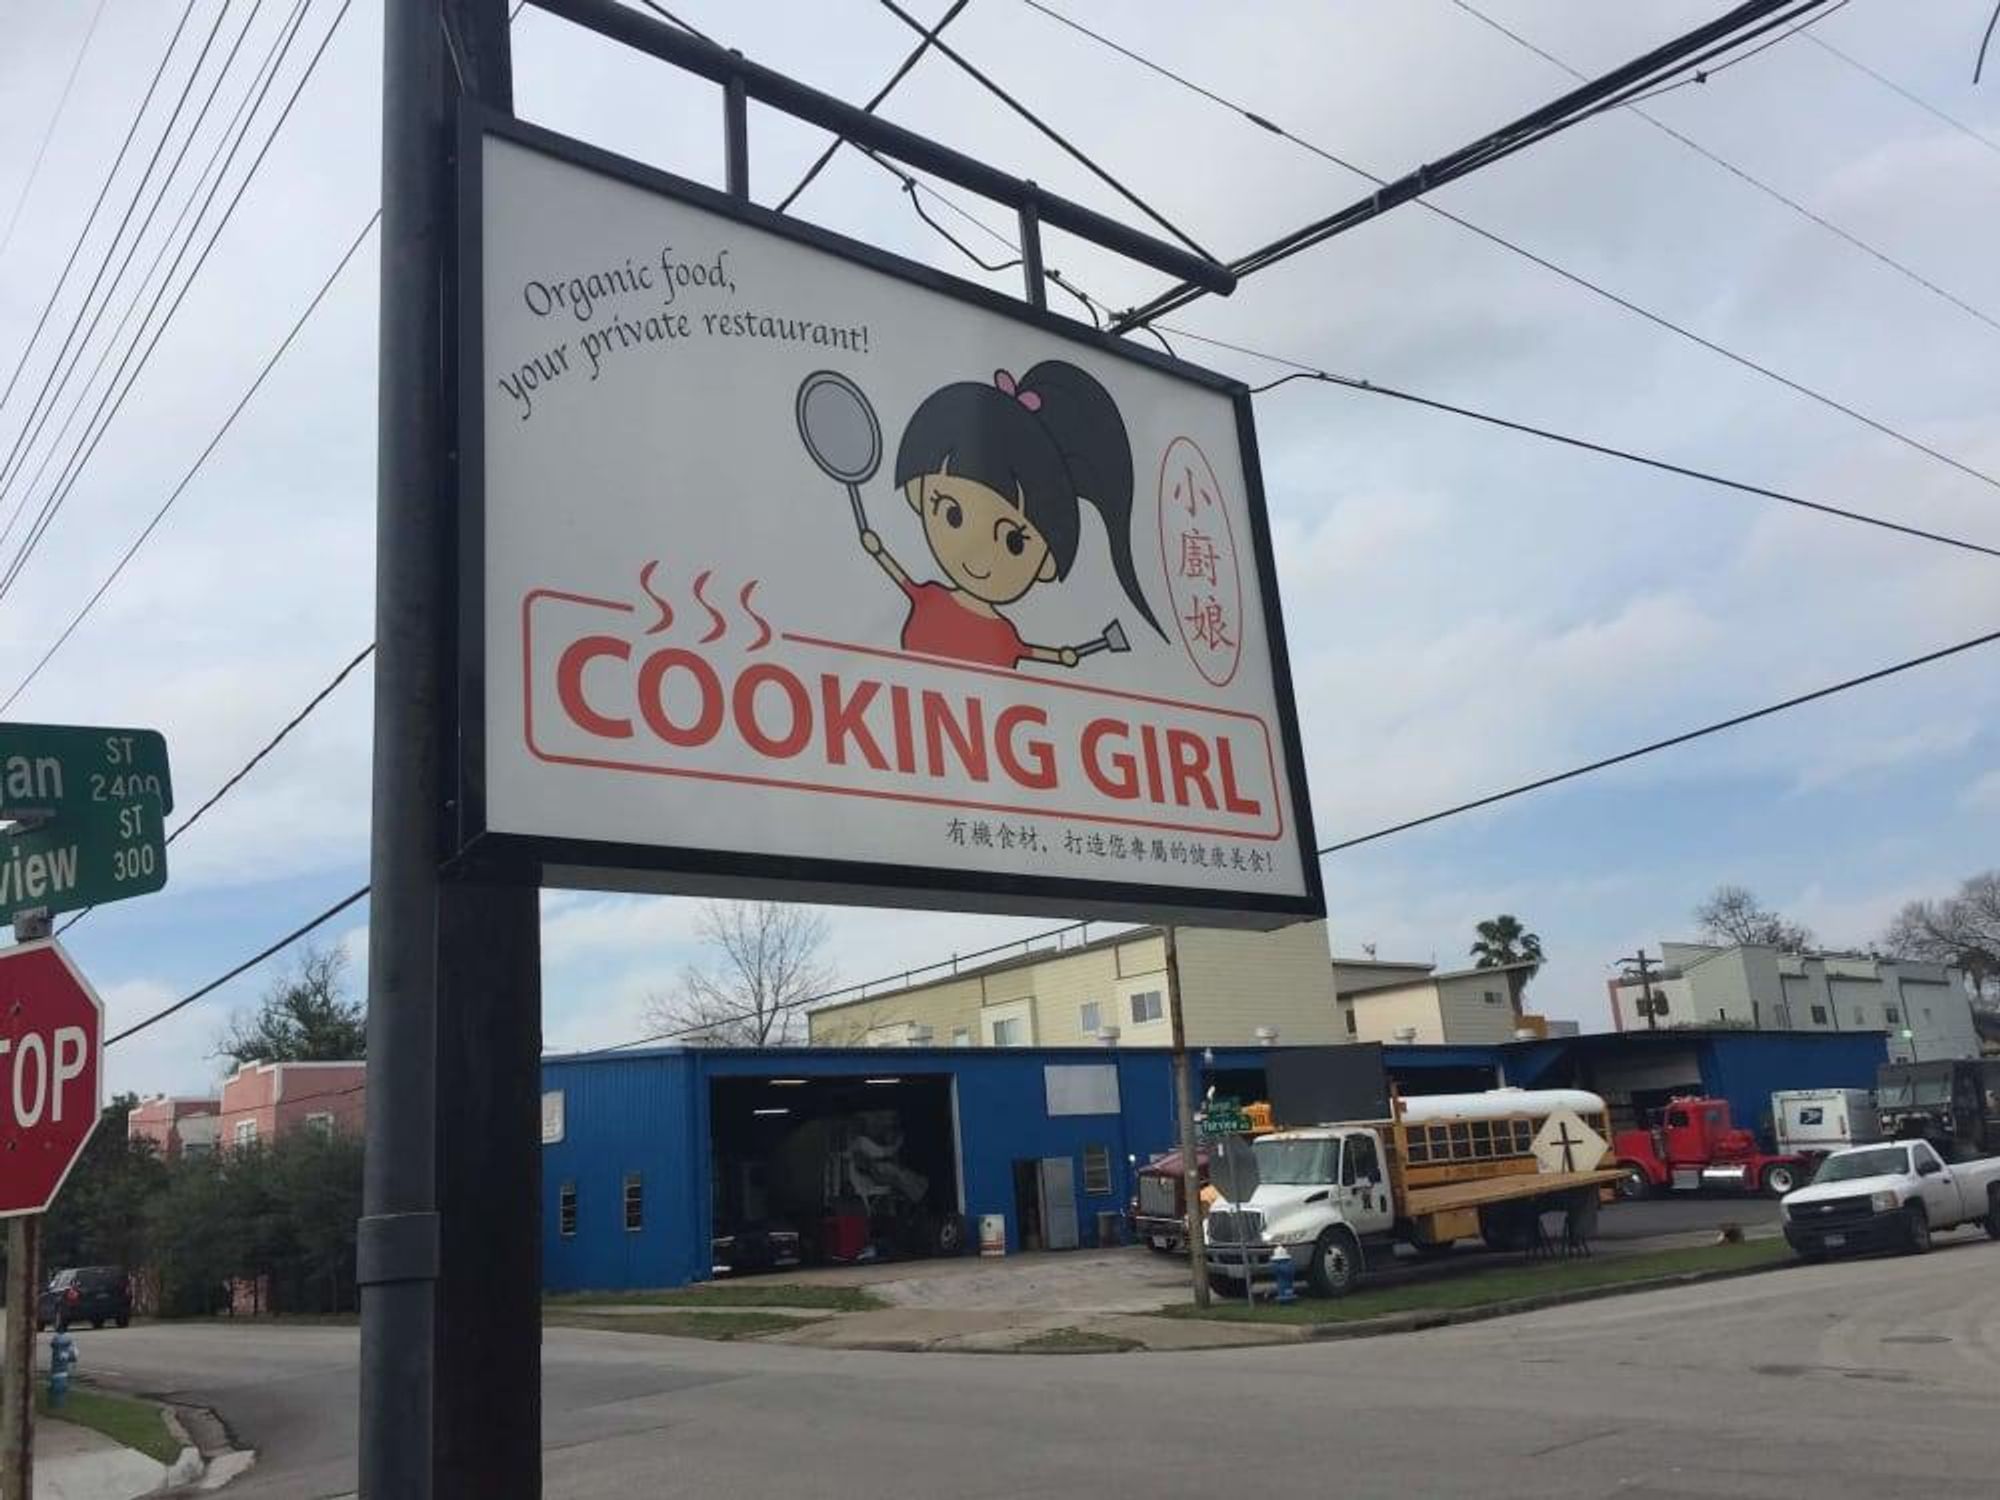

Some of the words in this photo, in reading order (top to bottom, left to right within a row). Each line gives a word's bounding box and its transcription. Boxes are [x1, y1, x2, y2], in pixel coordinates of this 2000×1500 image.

[523, 258, 653, 322] Organic
[661, 247, 736, 305] food,
[499, 341, 570, 420] your
[580, 311, 692, 381] private
[702, 310, 870, 354] restaurant!
[106, 737, 134, 764] ST
[556, 634, 1058, 791] COOKING
[1080, 720, 1262, 816] GIRL
[0, 755, 64, 806] an
[120, 805, 143, 839] ST
[113, 844, 154, 881] 300
